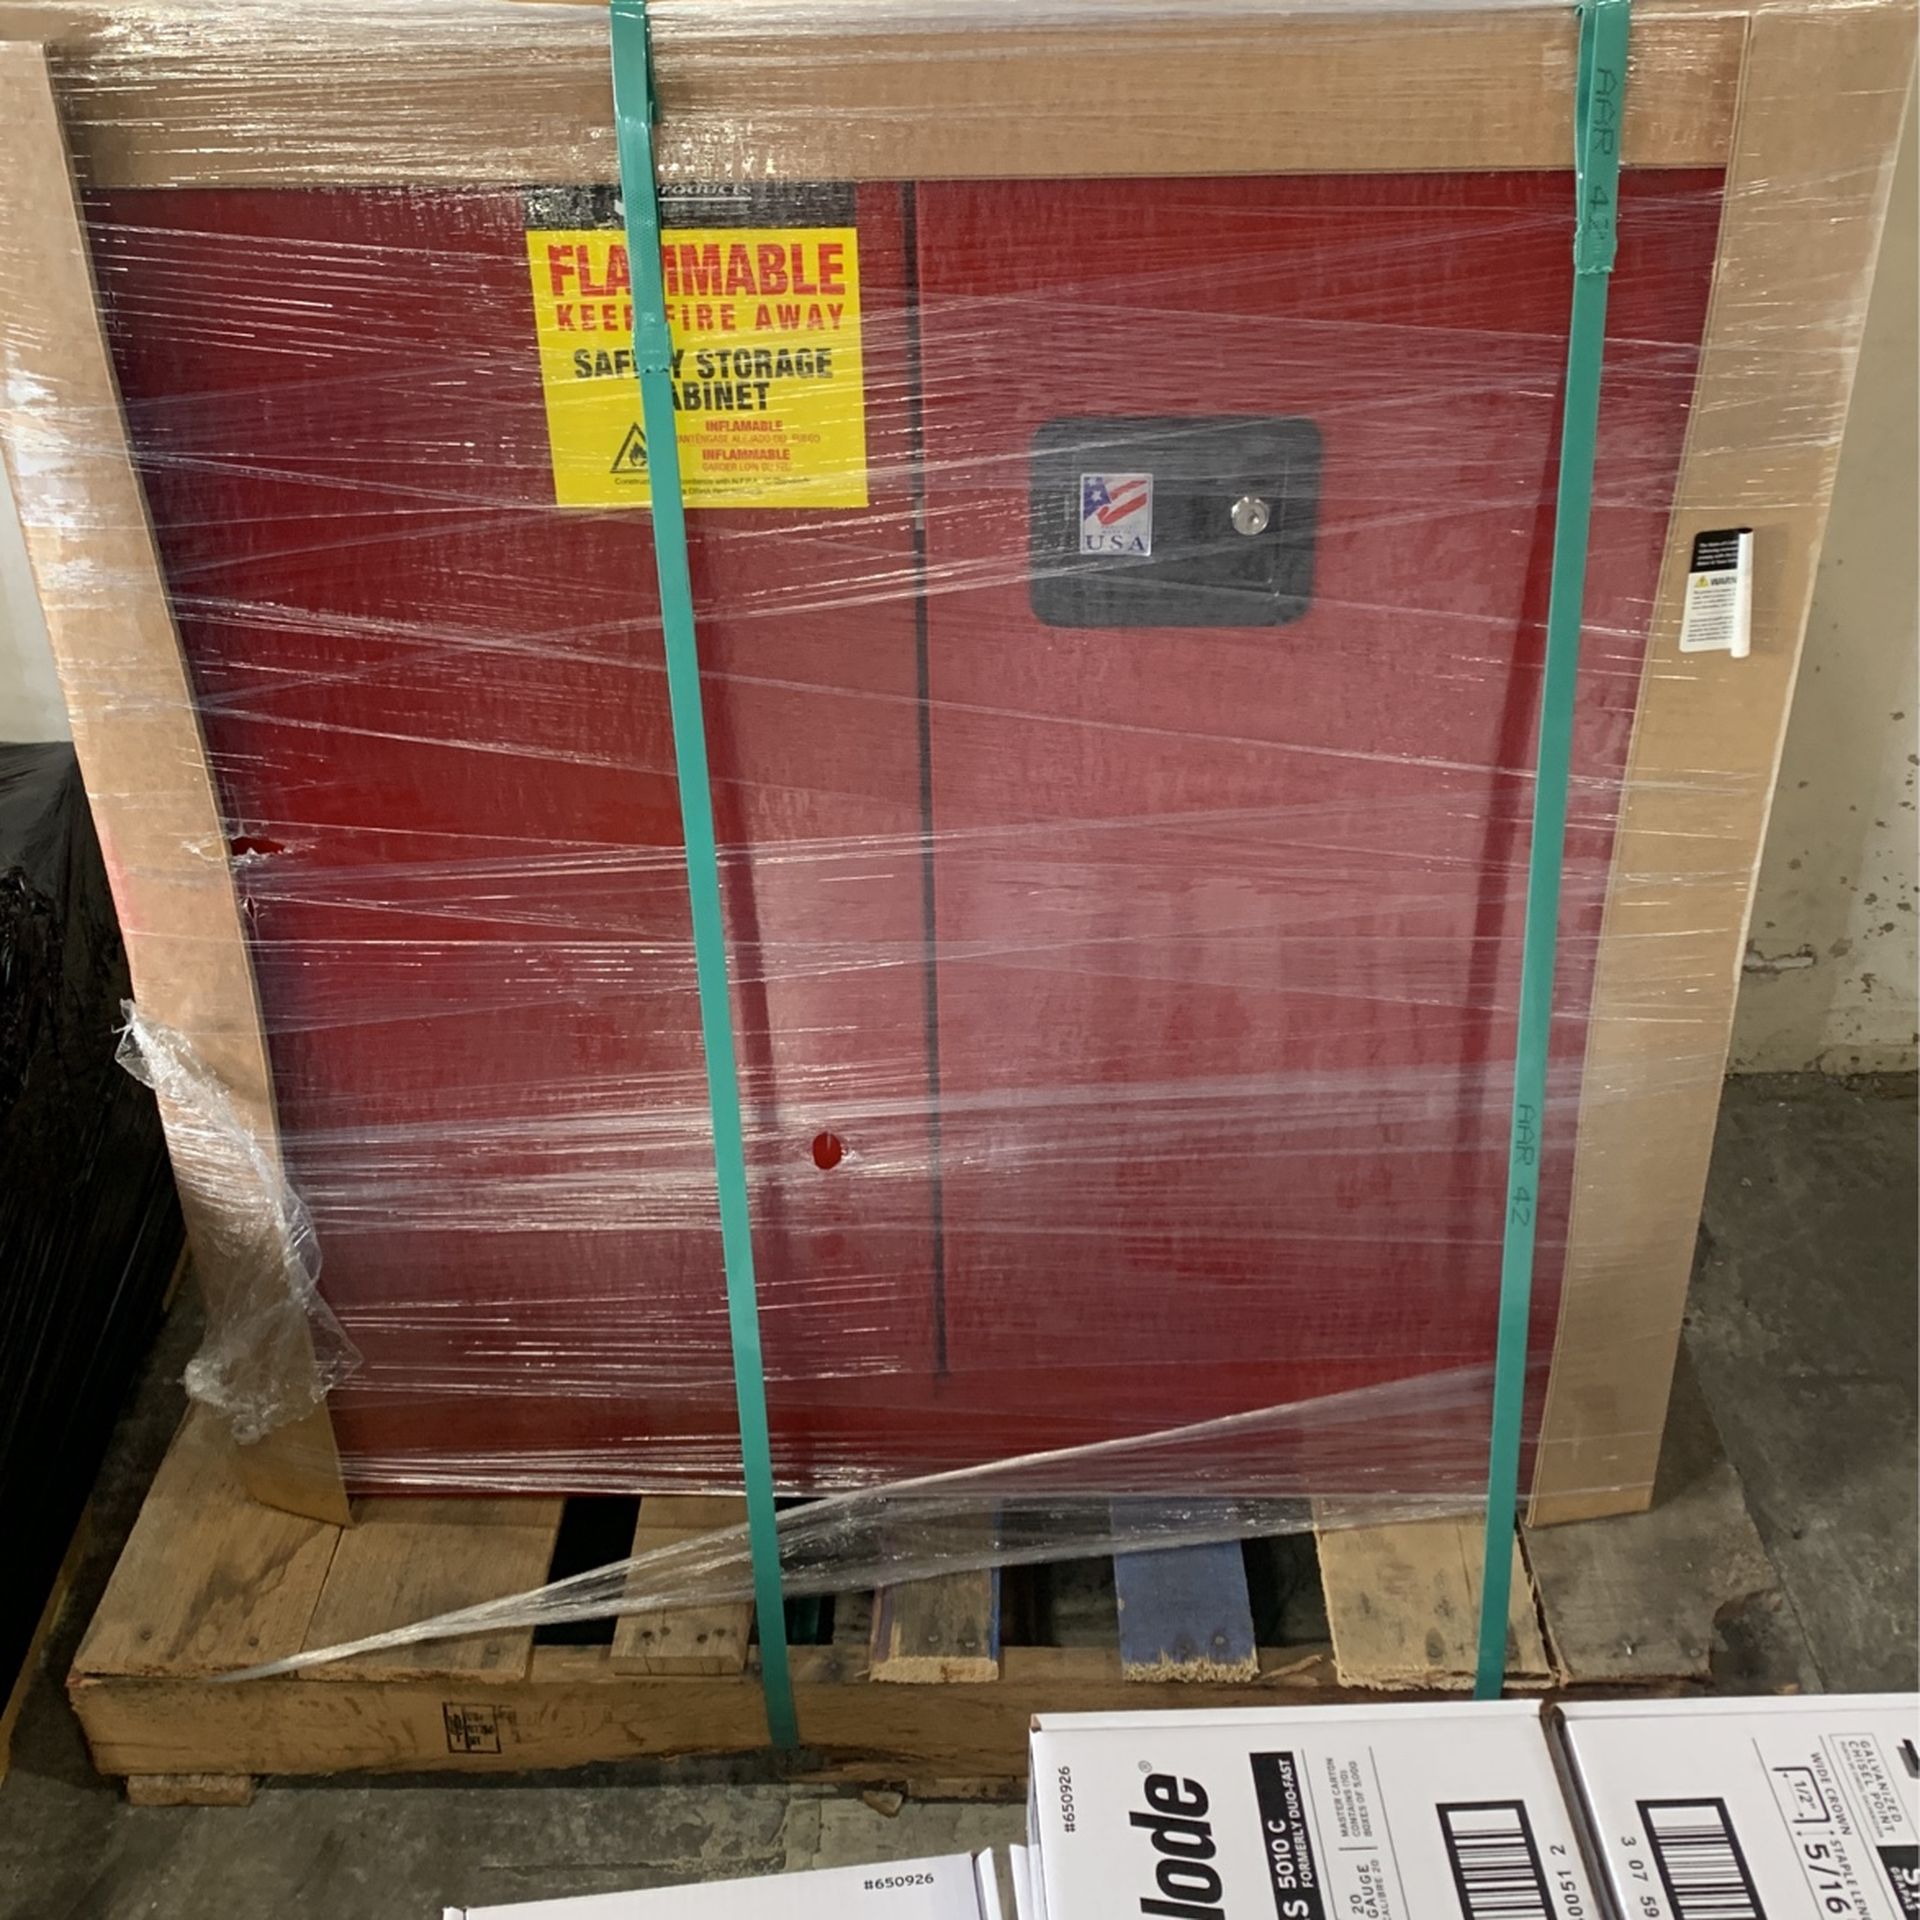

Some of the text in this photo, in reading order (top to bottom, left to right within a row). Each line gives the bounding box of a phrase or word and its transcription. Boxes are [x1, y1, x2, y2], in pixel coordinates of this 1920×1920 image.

[660, 181, 752, 195] roducts
[755, 303, 845, 331] AWAY
[574, 348, 832, 379] SAFY STORAGE
[672, 381, 770, 411] ABINET
[705, 420, 783, 432] INFLAMABLE
[702, 449, 790, 460] INFLAMMABLE
[1086, 535, 1145, 551] USA
[1511, 1104, 1536, 1227] AAR 42
[1058, 1765, 1076, 1833] #650926
[1326, 1757, 1349, 1838] MASTER CARTON
[1340, 1770, 1361, 1837] CONTAINS (10)
[1355, 1791, 1366, 1804] OF
[1811, 1752, 1852, 1836] WIDE CROWN
[1849, 1741, 1873, 1786] CHISEL
[1870, 1792, 1896, 1832] POINT
[1860, 1740, 1903, 1823] GALVANIZED
[1268, 1819, 1286, 1833] C
[1278, 1759, 1314, 1888] FORMERLY DUO-FAST
[1359, 1805, 1373, 1838] BOXES
[864, 1873, 934, 1891] #650926
[1271, 1839, 1297, 1889] 5010
[1370, 1859, 1381, 1874] 20
[1550, 1844, 1583, 1919] 0051 2
[1621, 1836, 1637, 1847] 3
[1629, 1860, 1649, 1882] 07
[1804, 1844, 1851, 1914] 5/16
[1830, 1839, 1858, 1887] STAPLE
[1350, 1894, 1365, 1915] 20
[1357, 1863, 1379, 1919] GAUGE
